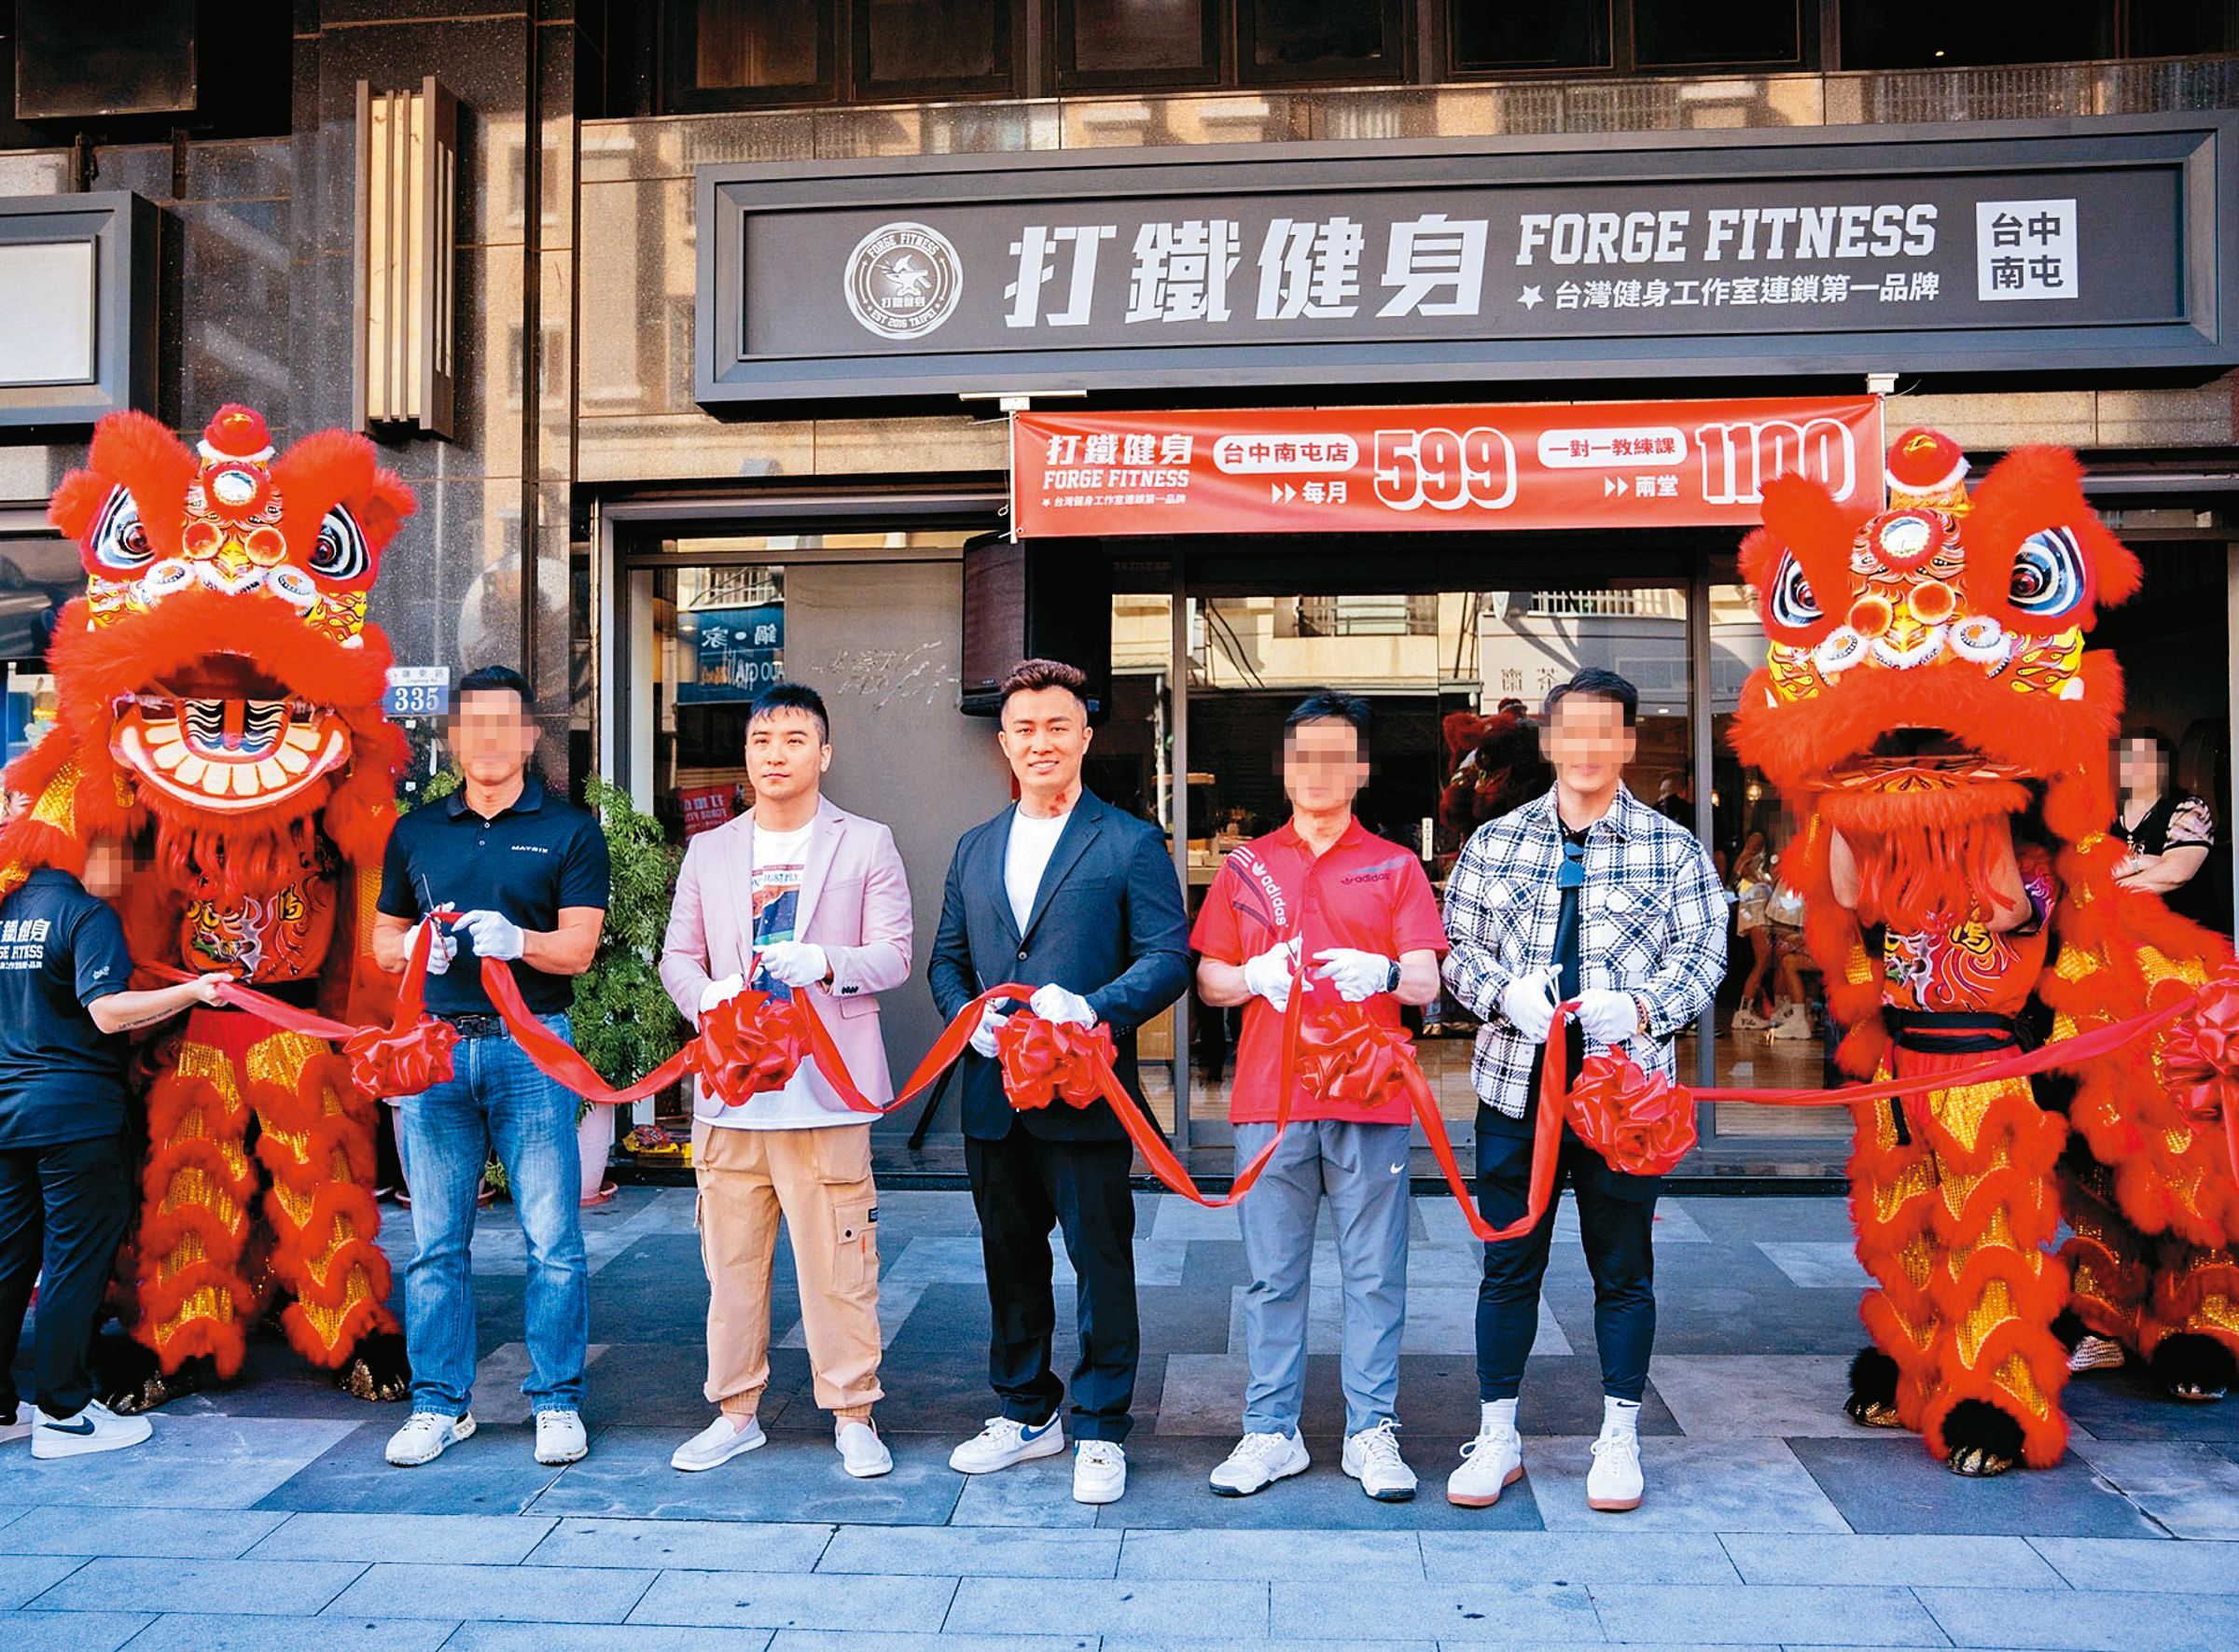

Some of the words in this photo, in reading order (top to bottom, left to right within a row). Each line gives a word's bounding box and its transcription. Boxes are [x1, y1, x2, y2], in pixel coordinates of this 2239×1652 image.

[1515, 210, 1690, 266] FORGE
[1704, 203, 1939, 261] FITNESS
[1991, 211, 2061, 247] 台中
[866, 234, 897, 259] FORGE
[899, 232, 940, 256] FITNESS
[1004, 214, 1490, 328] 打鐵健身
[1990, 254, 2064, 290] 南屯
[1554, 271, 1940, 311] 台灣健身工作室連鎖第一品牌
[870, 309, 887, 324] EST
[909, 309, 938, 327] TAIPEI
[1046, 434, 1193, 466] 打鐵健身
[1223, 442, 1349, 465] 台中南屯店
[1549, 437, 1676, 458] 一對一教練課
[1694, 418, 1856, 505] 1100
[1042, 470, 1105, 490] FORGE
[1107, 469, 1190, 488] FITNESS
[1373, 426, 1517, 511] 599
[1301, 480, 1348, 505] 每月
[1634, 474, 1679, 498] 兩堂
[395, 687, 440, 712] 335
[1355, 872, 1391, 883] adidas
[1260, 875, 1286, 926] adidas
